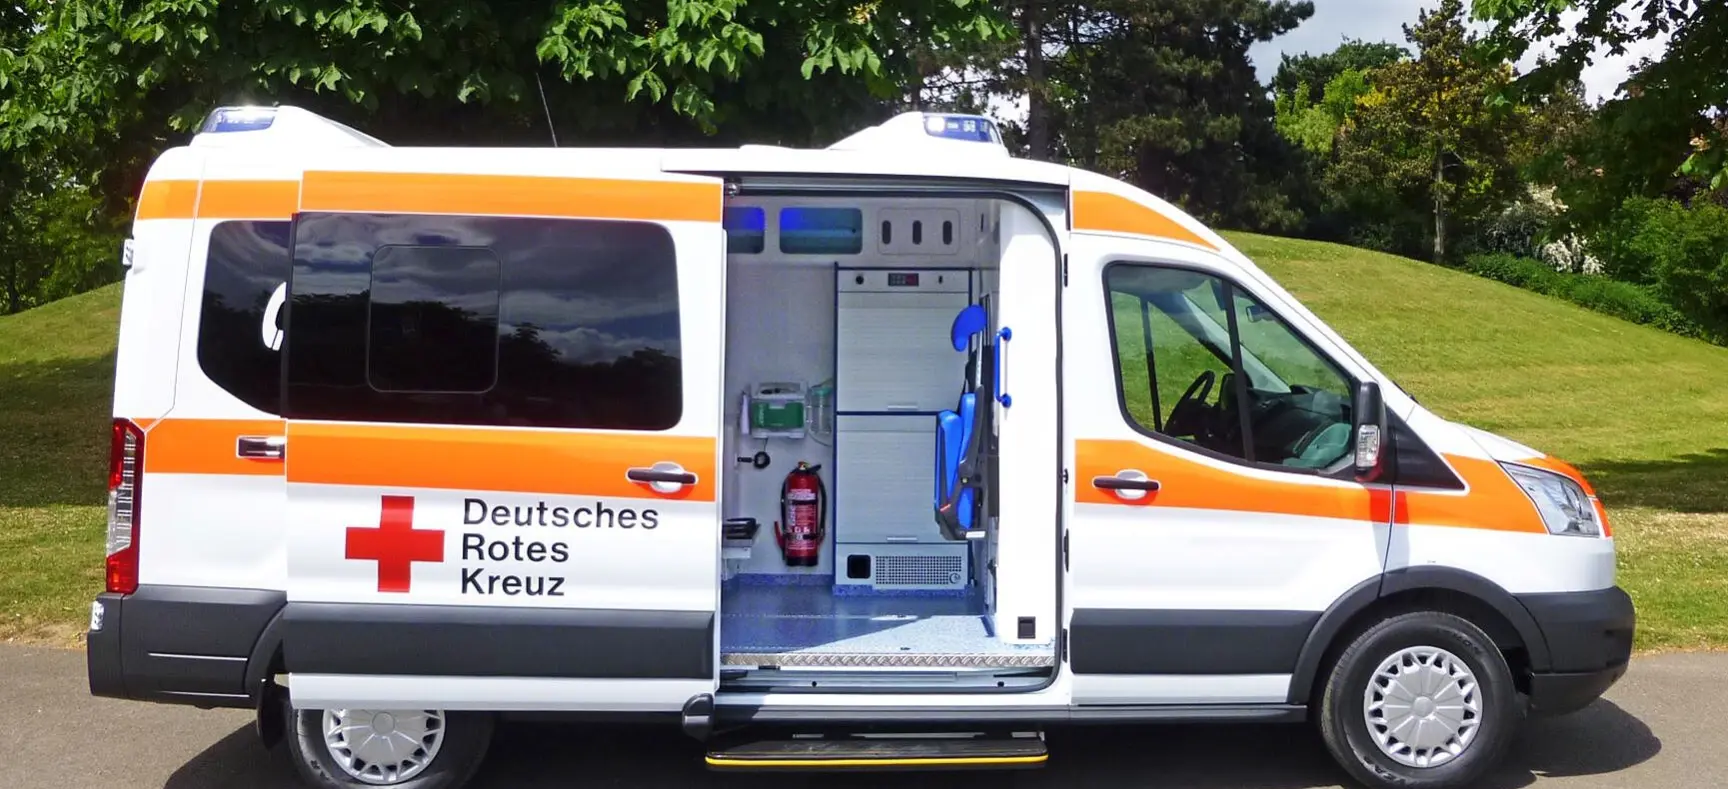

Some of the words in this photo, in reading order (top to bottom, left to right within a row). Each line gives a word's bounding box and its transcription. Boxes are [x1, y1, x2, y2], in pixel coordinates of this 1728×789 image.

[463, 498, 659, 530] Deutsches
[462, 532, 569, 563] Rotes
[461, 567, 565, 596] Kreuz
